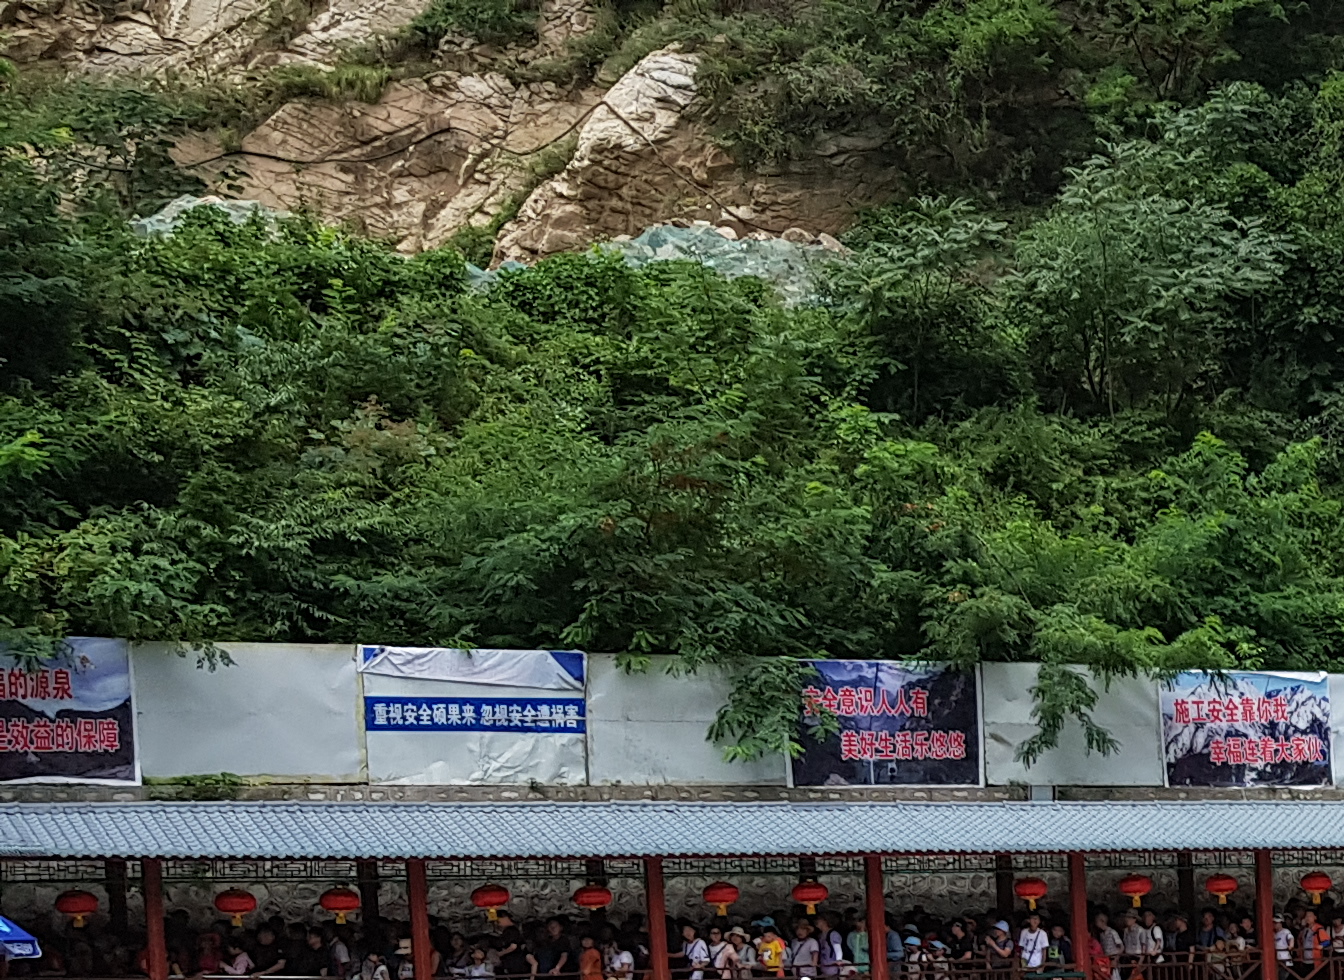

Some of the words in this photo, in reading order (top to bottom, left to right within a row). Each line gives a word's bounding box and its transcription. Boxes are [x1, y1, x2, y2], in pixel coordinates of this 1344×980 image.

[373, 703, 476, 726] 重视安全硕果来
[480, 704, 579, 728] 忽视安全遭祸害
[802, 686, 929, 717] 安全意识人人有
[1174, 697, 1289, 724] 施工安全靠你我
[840, 731, 966, 760] 美好生活乐悠悠
[1210, 736, 1324, 766] 幸福连着大家伙
